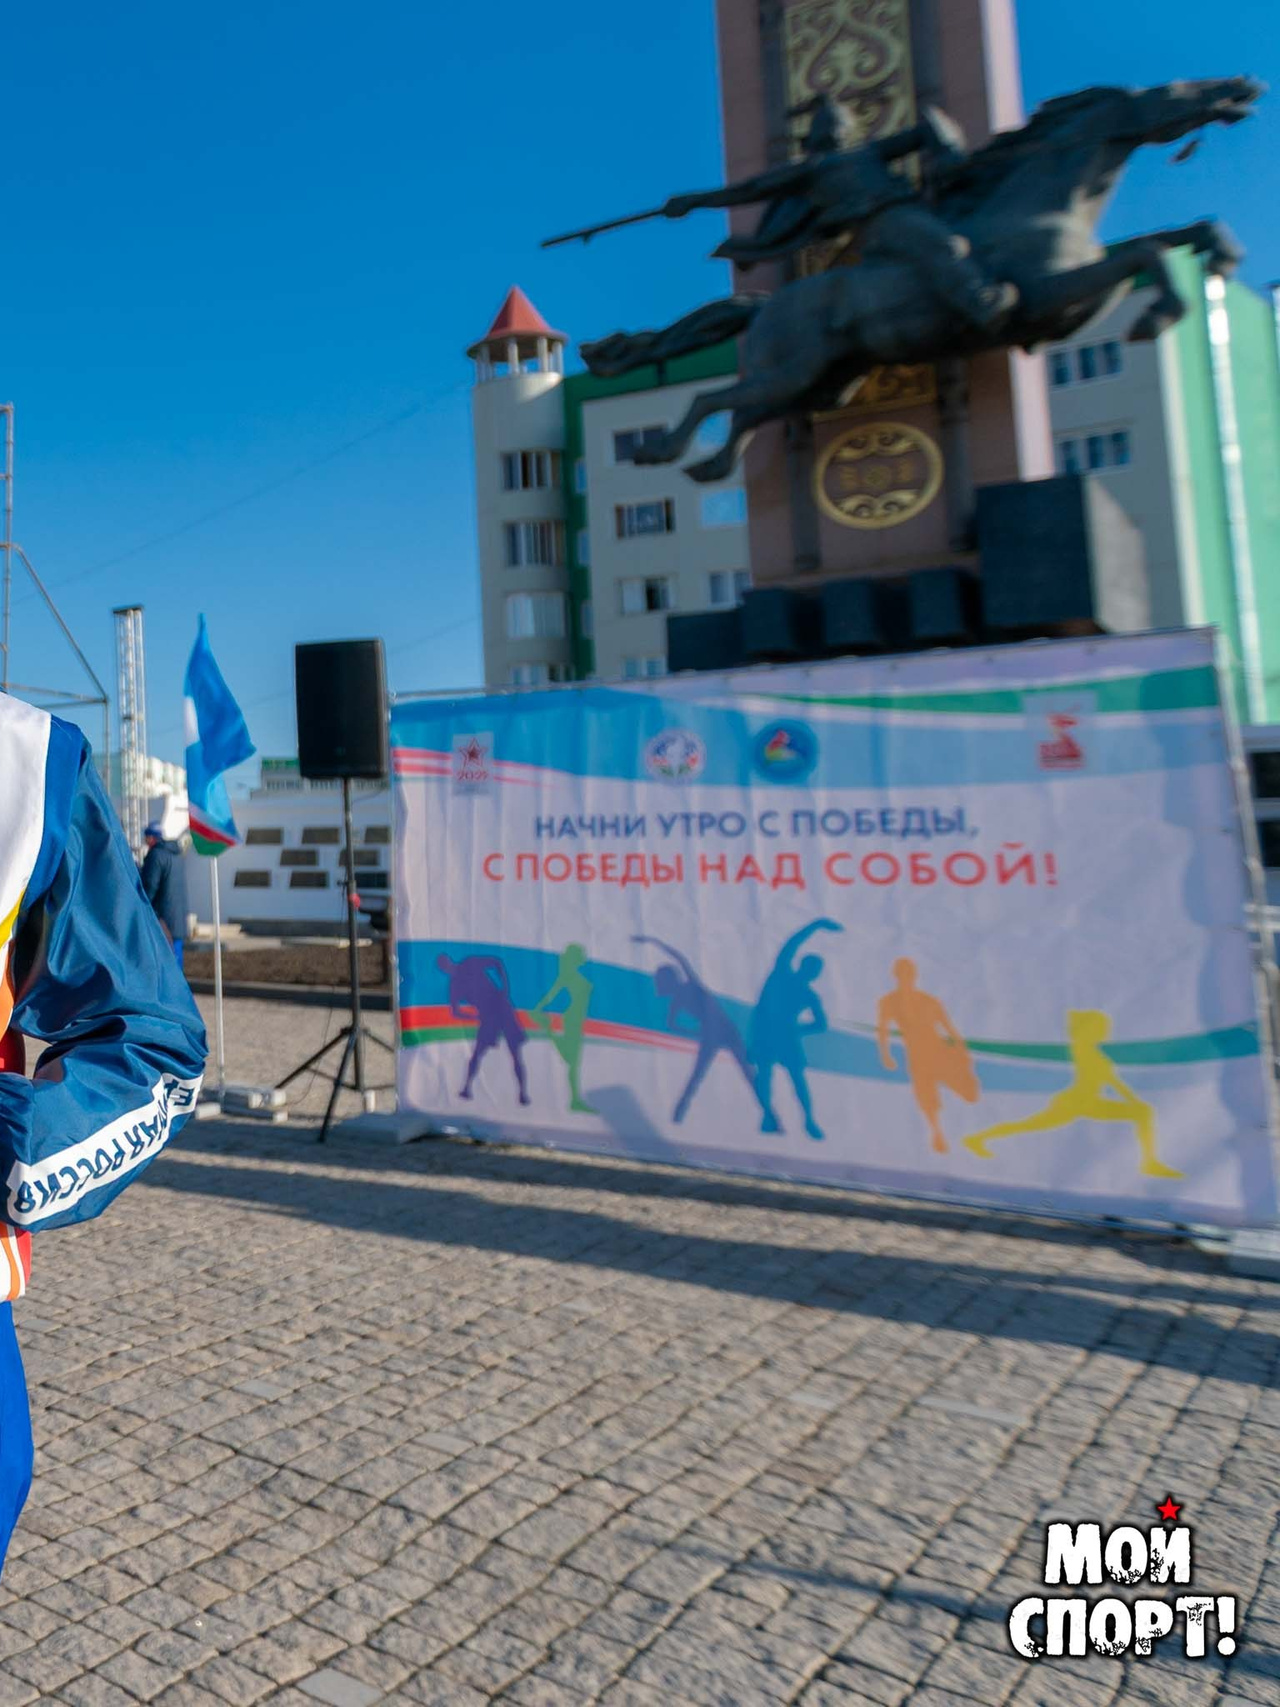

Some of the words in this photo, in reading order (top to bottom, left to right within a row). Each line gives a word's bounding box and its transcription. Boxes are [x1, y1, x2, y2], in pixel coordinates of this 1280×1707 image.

[535, 813, 646, 839] НАЧНИ
[657, 810, 747, 837] УТРО
[758, 809, 780, 837] С
[791, 806, 979, 839] ПОБЕДЫ,
[482, 853, 505, 881] С
[515, 853, 684, 888] ПОБЕДЫ
[698, 852, 806, 889] НАД
[823, 842, 1059, 887] СОБОЙ!
[13, 1138, 126, 1214] РОССИЯ
